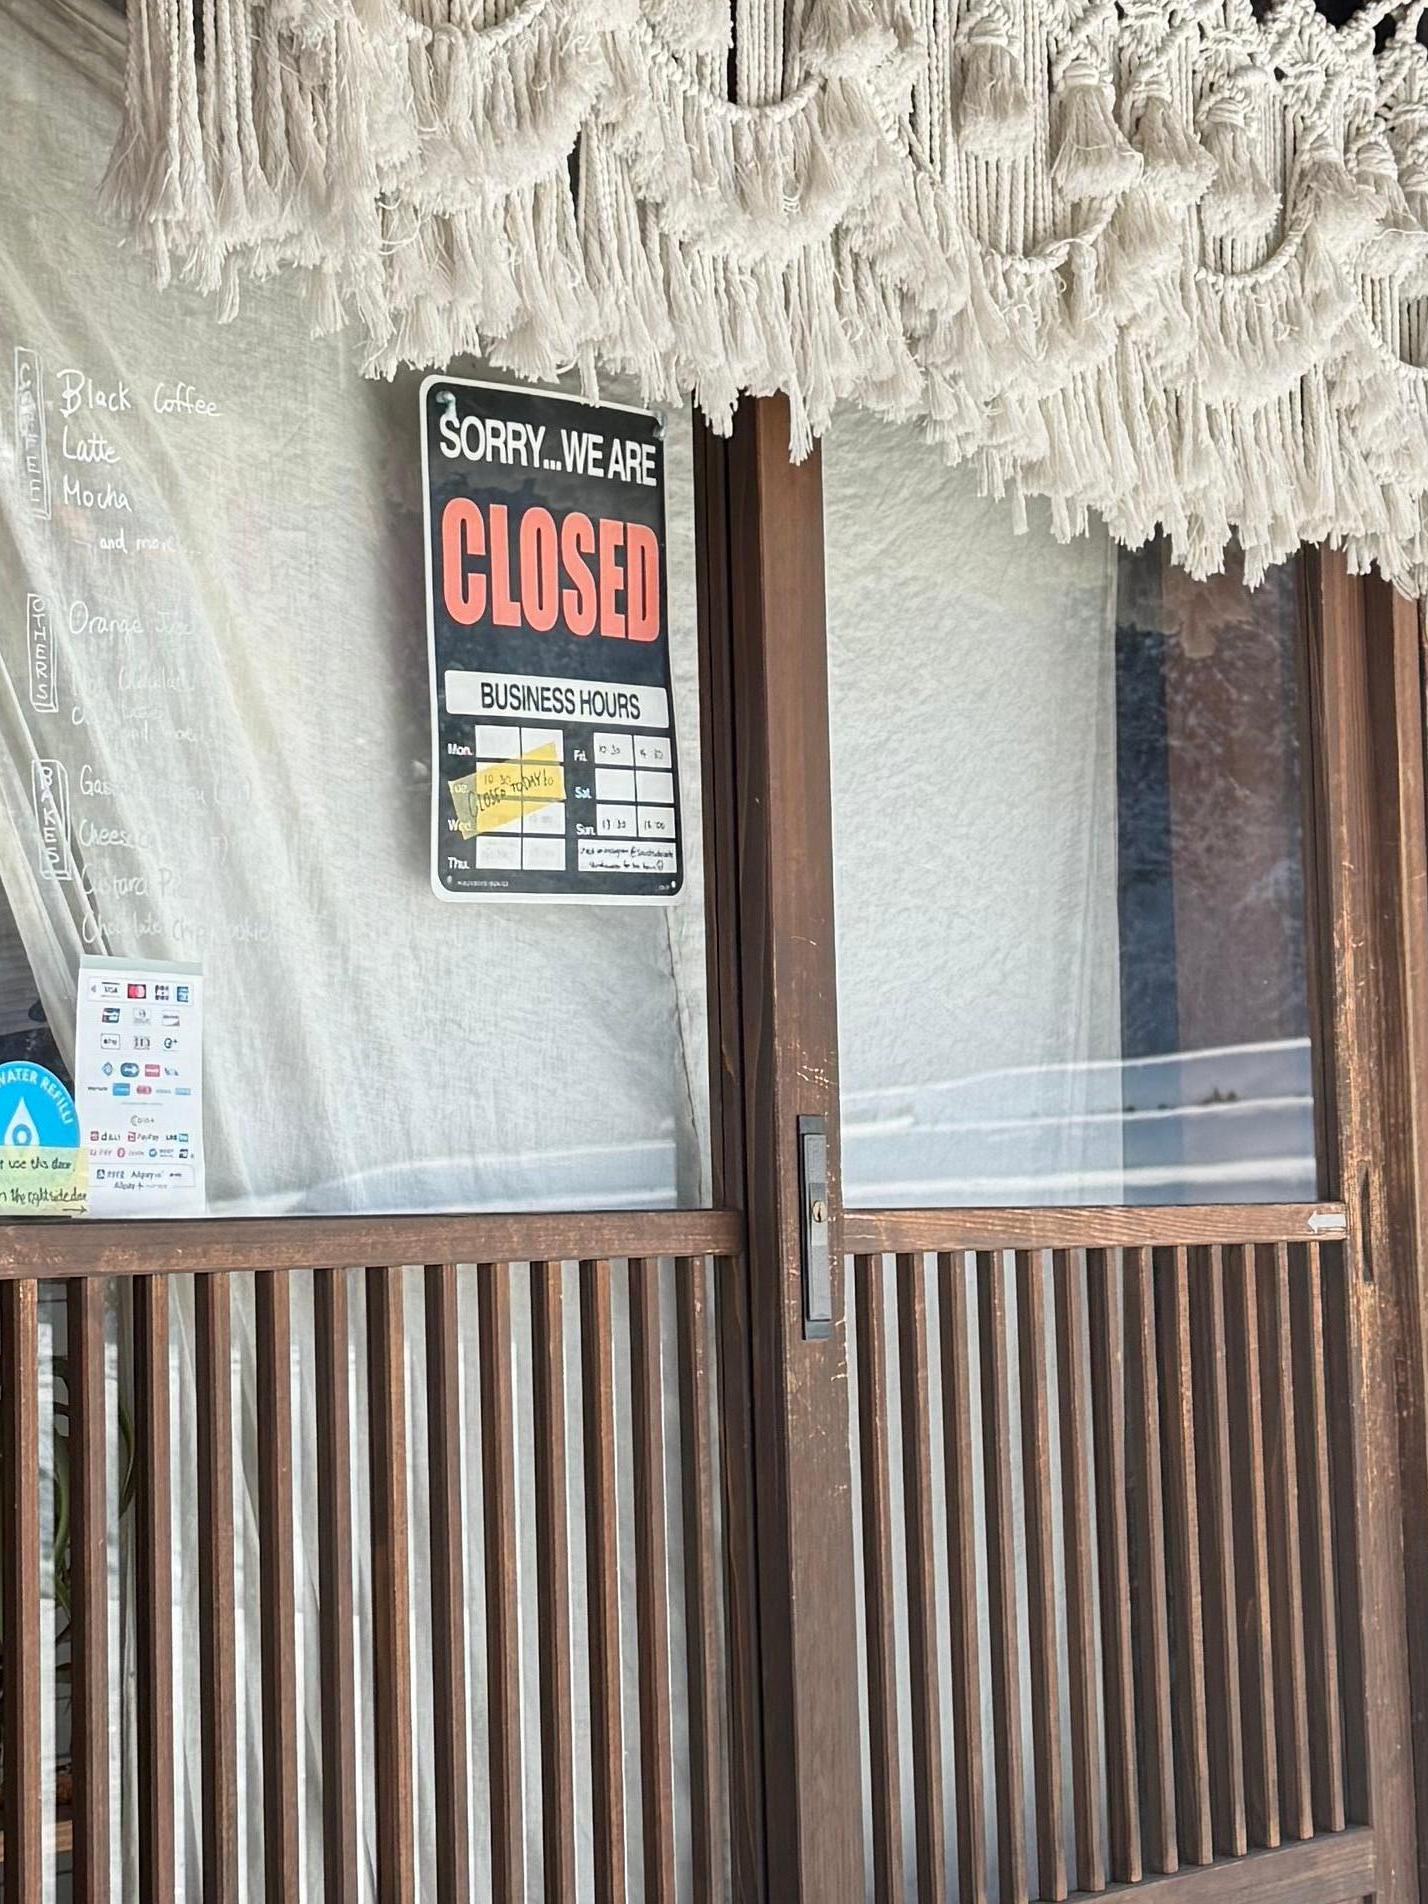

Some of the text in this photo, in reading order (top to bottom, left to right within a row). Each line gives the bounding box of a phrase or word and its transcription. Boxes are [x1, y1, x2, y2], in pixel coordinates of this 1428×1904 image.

[56, 368, 224, 418] Black Coffee
[62, 425, 122, 464] Latte
[607, 438, 658, 487] ARE
[63, 474, 133, 512] Mocha
[100, 528, 128, 555] and
[441, 497, 660, 643] CLOSED
[69, 600, 144, 644] Orange
[32, 598, 49, 700] OTHERS
[481, 682, 641, 720] BUSINESS HOURS
[447, 743, 473, 756] Mon.
[8, 1159, 27, 1170] use
[10, 1186, 27, 1206] the
